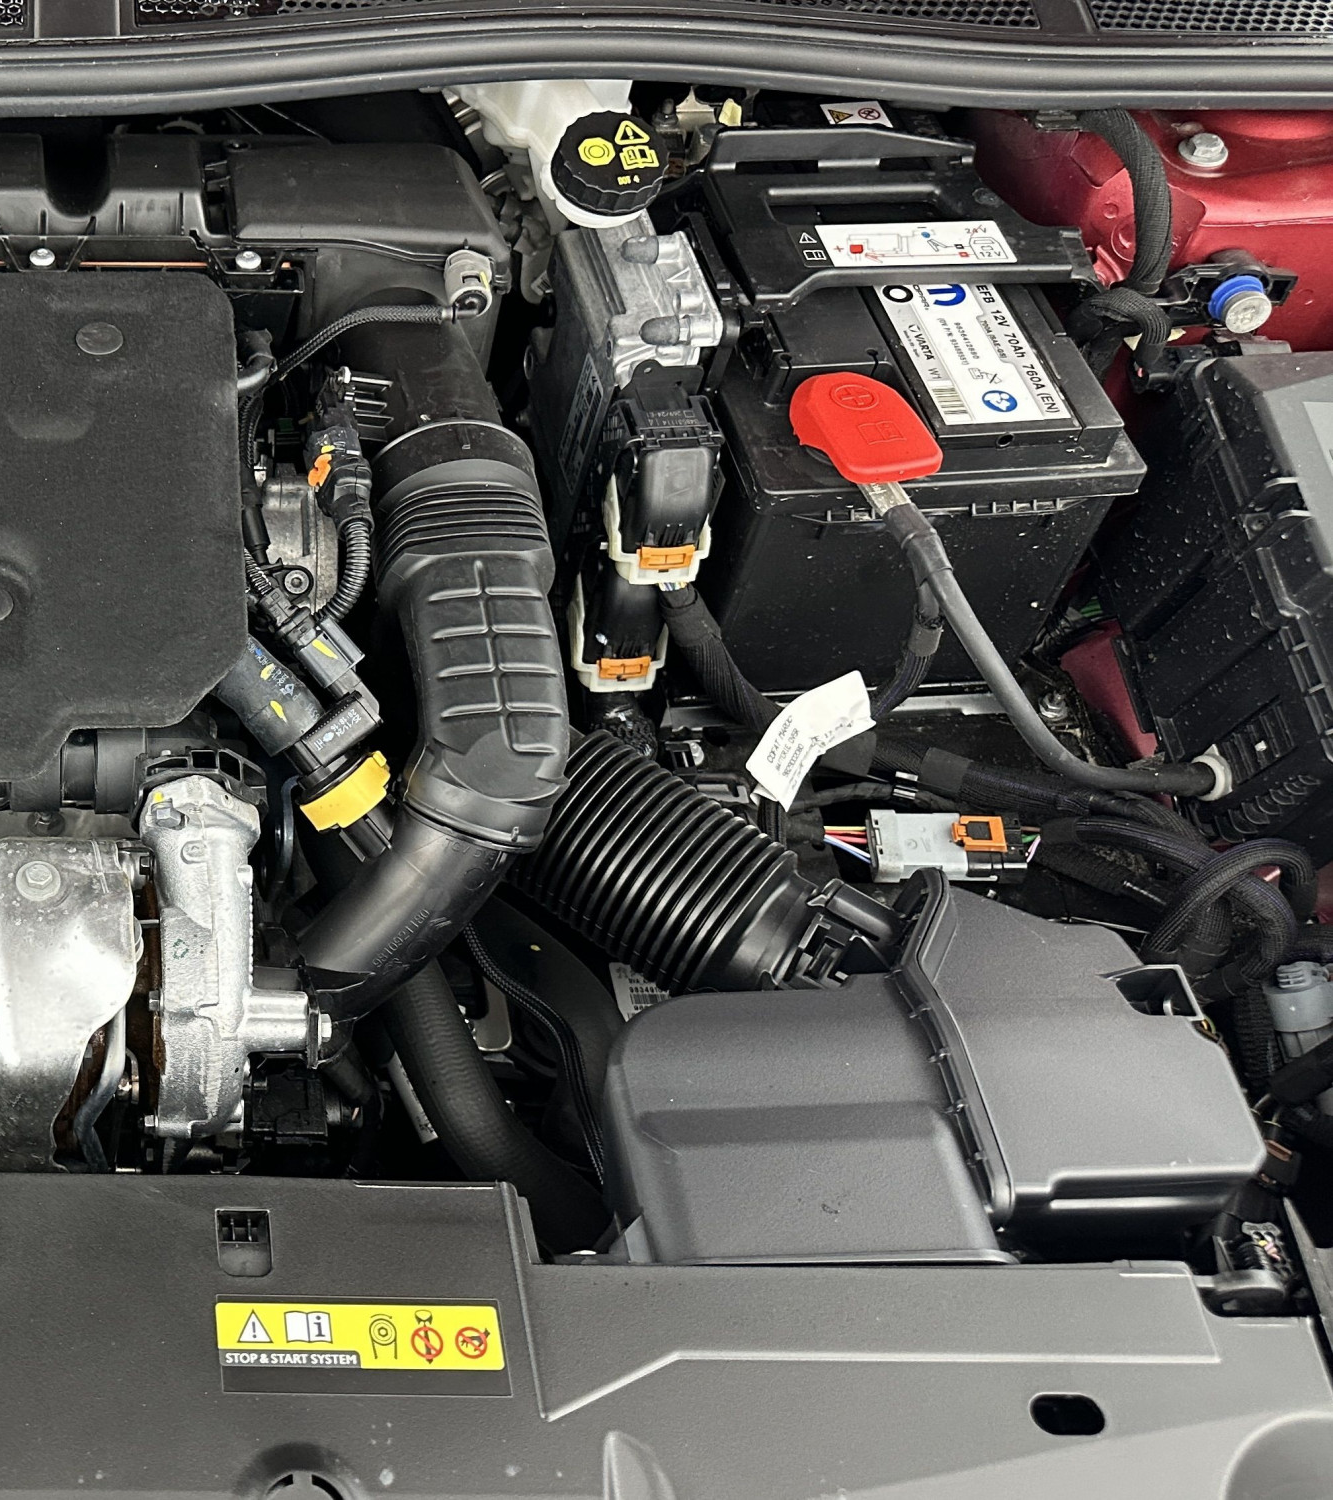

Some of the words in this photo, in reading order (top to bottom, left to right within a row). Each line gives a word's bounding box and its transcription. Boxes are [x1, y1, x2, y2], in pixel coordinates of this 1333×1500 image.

[913, 332, 935, 361] VARTA
[928, 367, 942, 380] W1
[975, 284, 996, 304] EFB
[990, 309, 1011, 327] 12V
[1004, 332, 1027, 358] 70Ah
[1021, 363, 1046, 391] 760A
[1038, 391, 1060, 413] (EN)
[225, 1352, 258, 1364] STOP
[260, 1353, 269, 1363] &
[271, 1353, 308, 1364] START
[310, 1354, 357, 1365] SYSTEM
